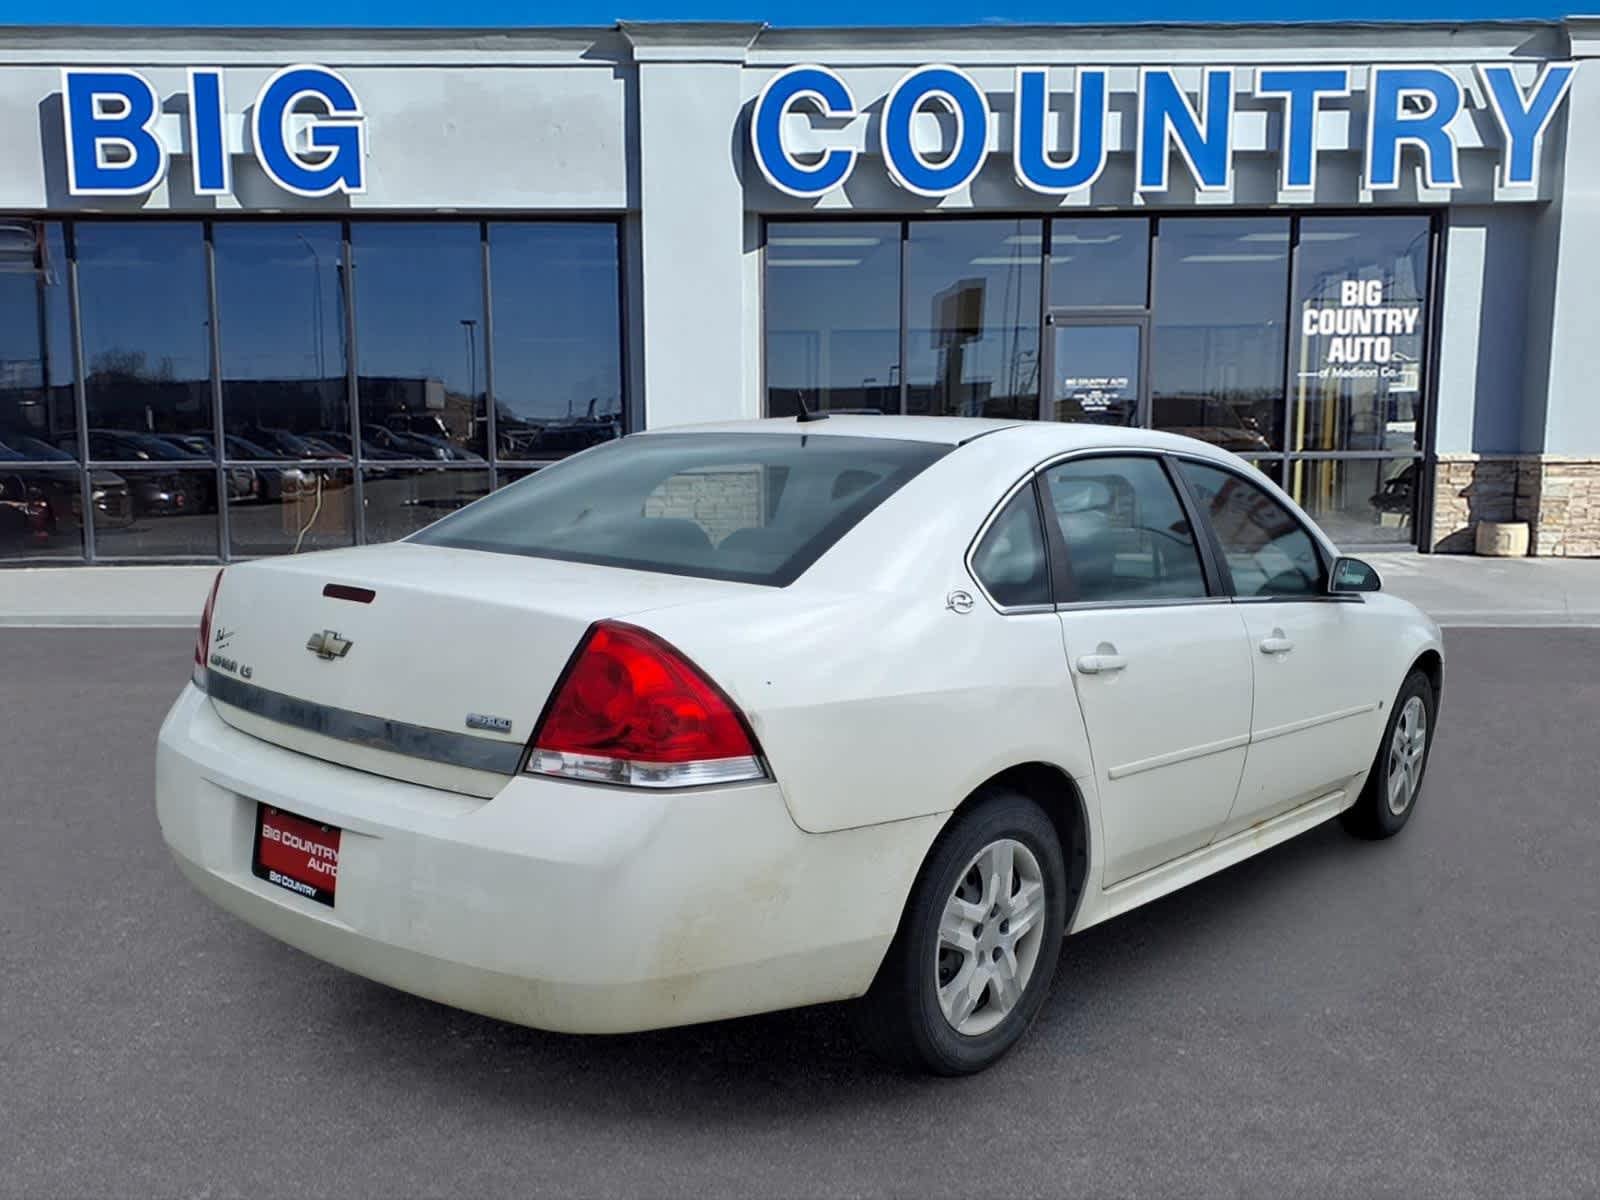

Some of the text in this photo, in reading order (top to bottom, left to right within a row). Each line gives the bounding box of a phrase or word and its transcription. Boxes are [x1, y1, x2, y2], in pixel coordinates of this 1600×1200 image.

[61, 61, 1574, 200] BIG COUNTRY
[1341, 280, 1382, 307] BIG
[1303, 308, 1420, 335] COUNTRY
[1328, 337, 1391, 362] AUTO
[1319, 367, 1328, 377] of
[1331, 367, 1378, 377] Madison
[262, 824, 339, 861] BIG COUNTRY
[269, 870, 317, 897] BIG COUNTRY
